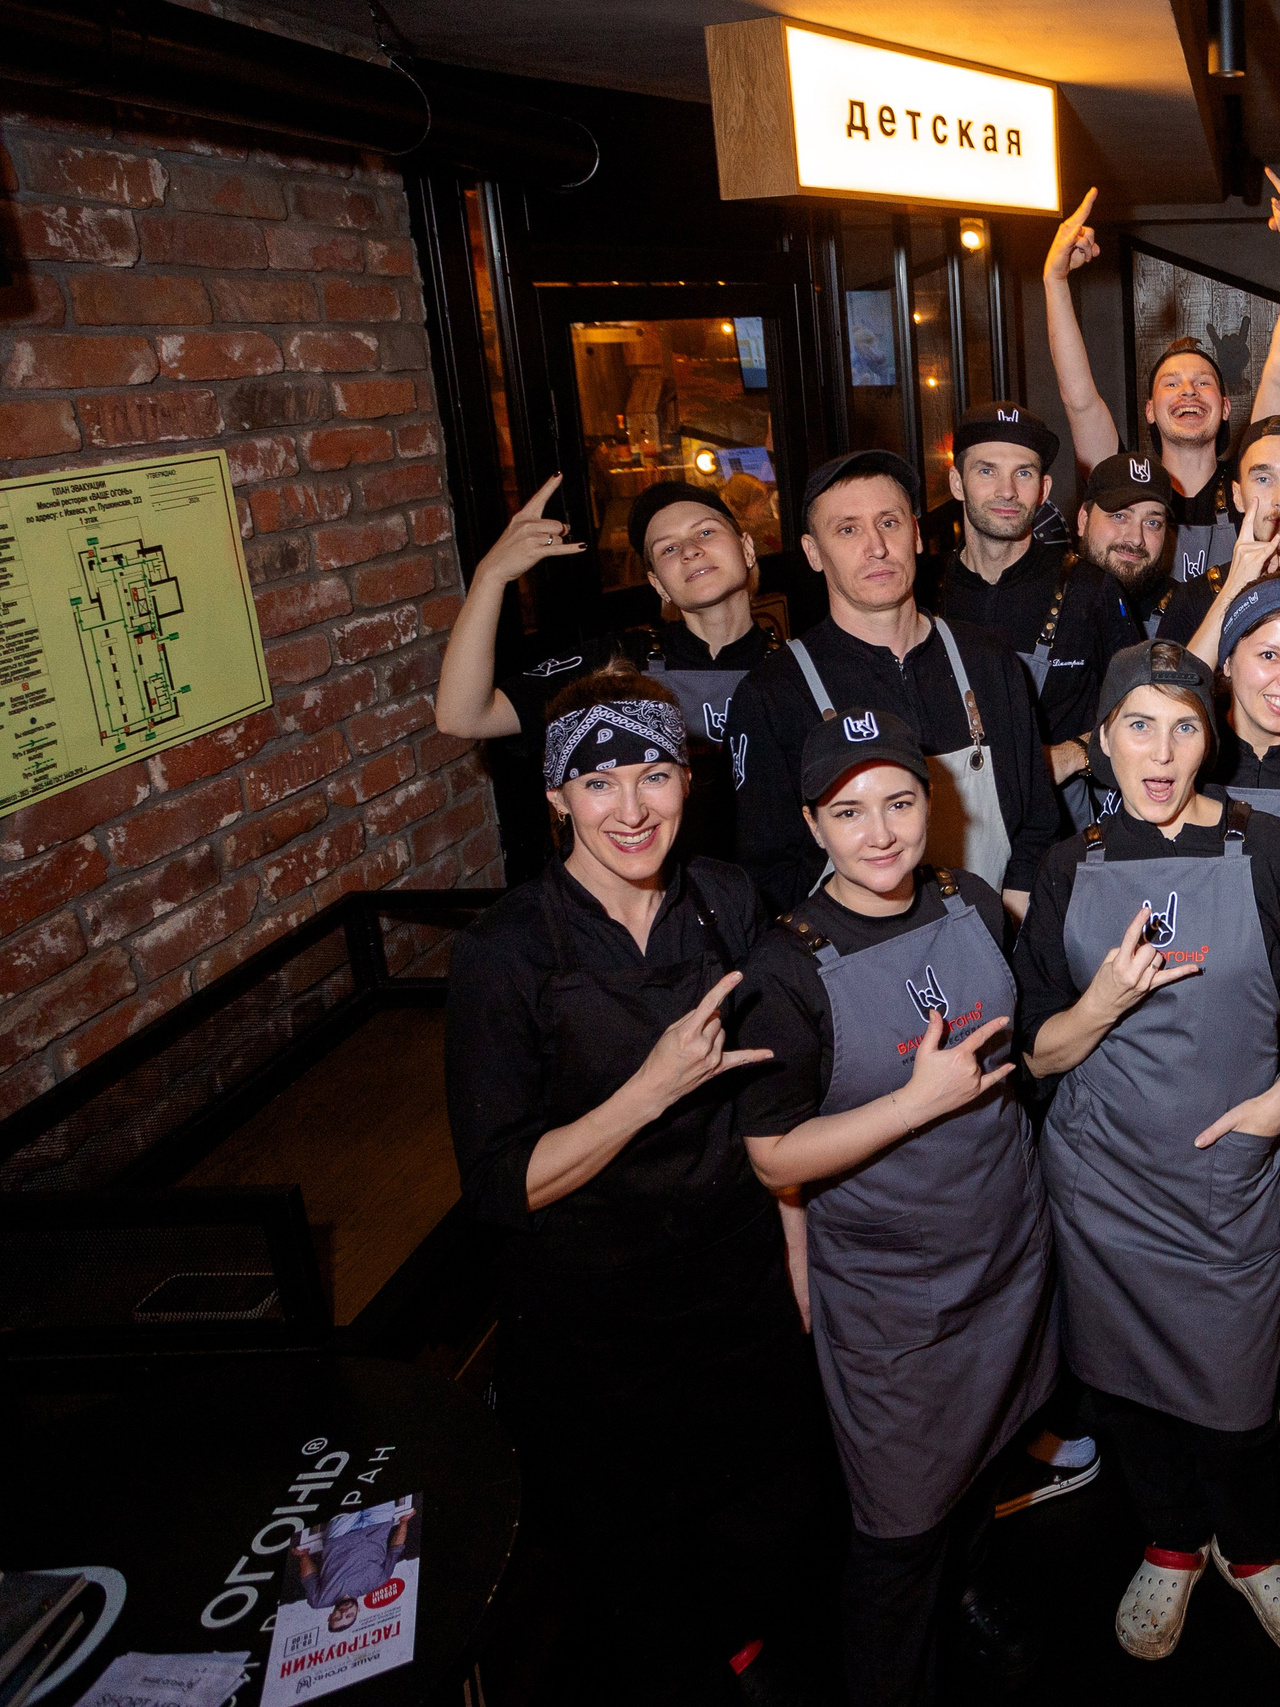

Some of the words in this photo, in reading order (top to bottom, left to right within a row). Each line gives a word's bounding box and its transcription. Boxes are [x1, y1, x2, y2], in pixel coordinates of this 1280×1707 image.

[846, 98, 1023, 157] детская
[51, 485, 70, 496] ПЛАН
[279, 1620, 401, 1679] ГАСТРОУЖИН
